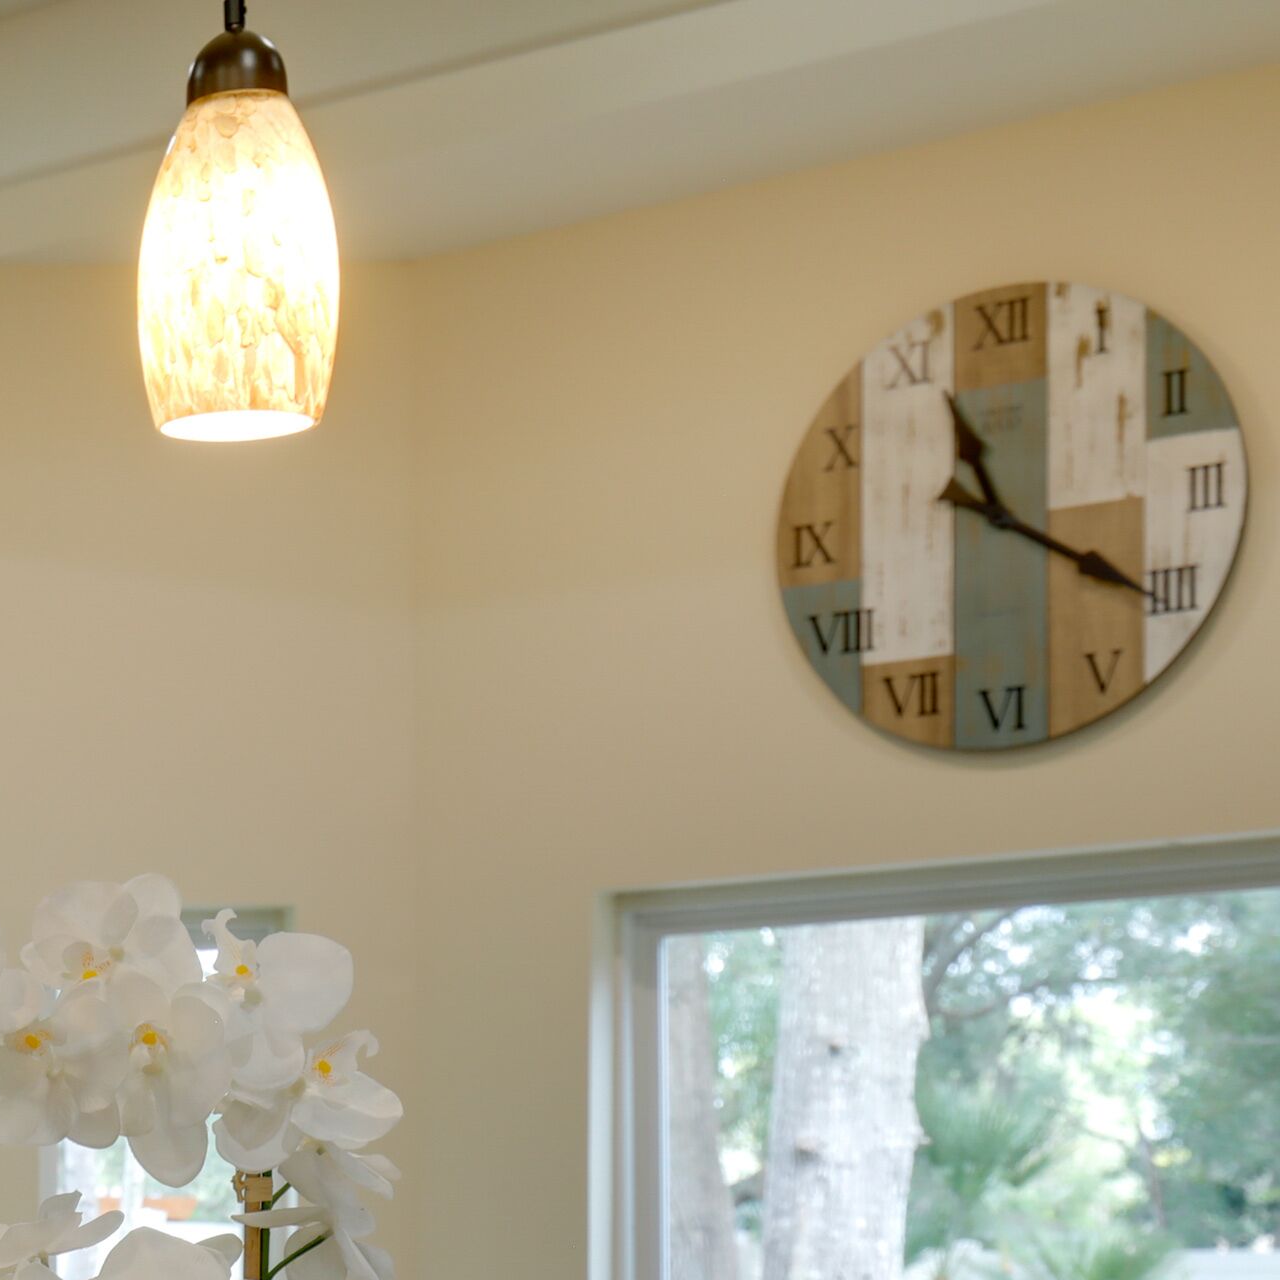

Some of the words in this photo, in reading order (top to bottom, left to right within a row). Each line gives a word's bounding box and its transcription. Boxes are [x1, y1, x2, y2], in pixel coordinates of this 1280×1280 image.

[973, 298, 1030, 351] XII
[1093, 304, 1109, 354] I
[884, 342, 933, 391] XI
[1163, 369, 1189, 418] II
[823, 424, 859, 473] X
[1187, 461, 1225, 512] III
[792, 521, 835, 569] IX
[808, 609, 874, 655] VIII
[883, 671, 941, 717] VII
[1085, 648, 1123, 695] V
[978, 684, 1026, 731] VI
